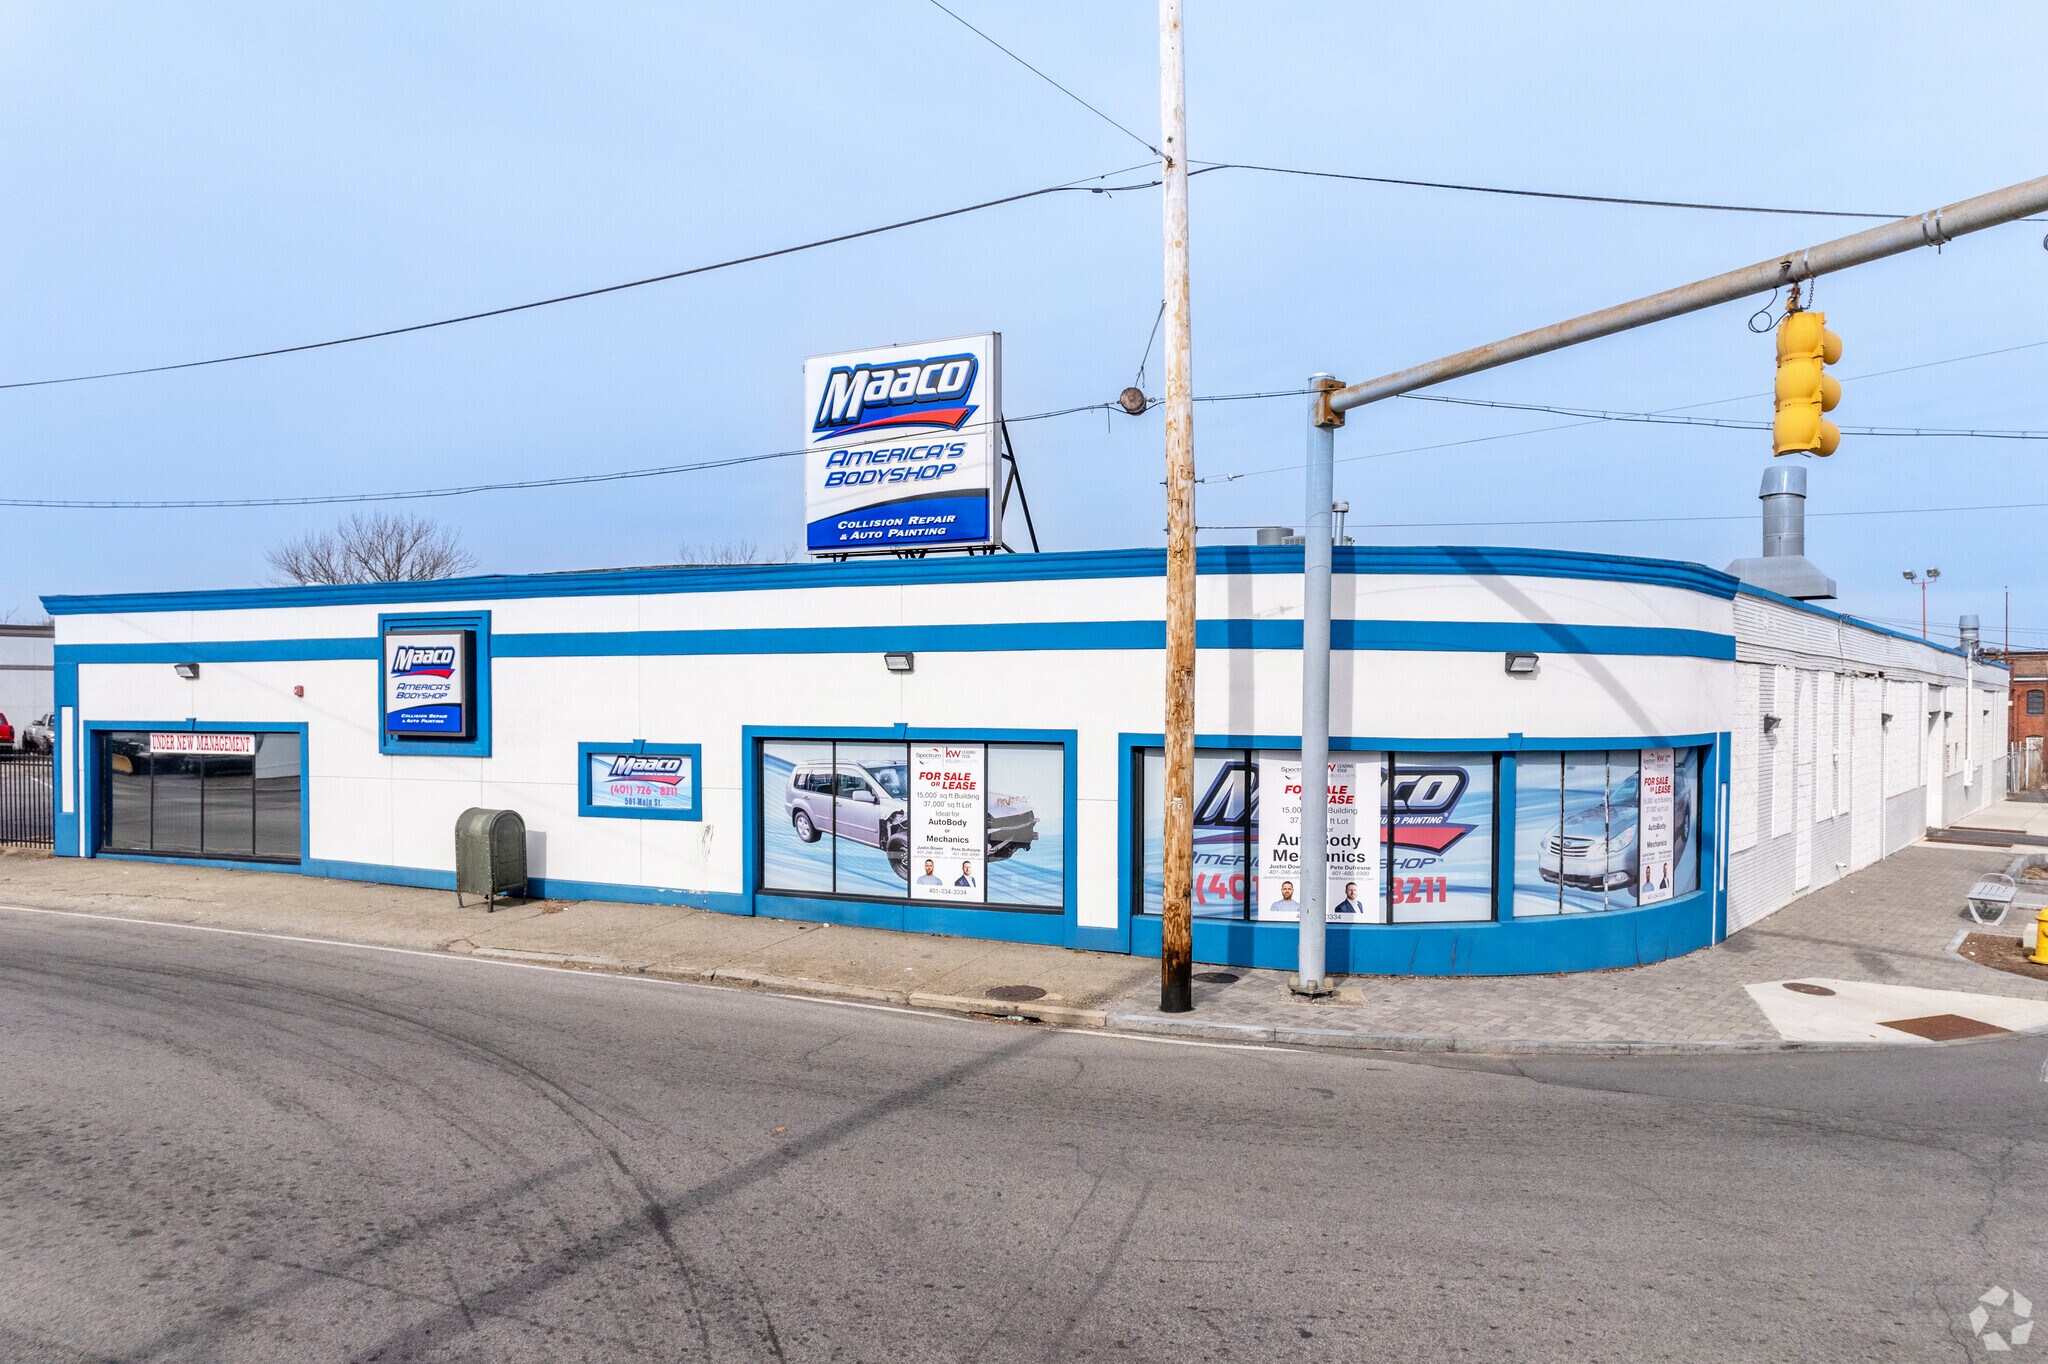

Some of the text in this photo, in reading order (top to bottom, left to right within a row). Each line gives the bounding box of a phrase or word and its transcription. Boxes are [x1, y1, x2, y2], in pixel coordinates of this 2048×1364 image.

[819, 359, 972, 424] Maaco
[826, 442, 967, 468] AMERICA'S
[825, 463, 958, 488] BODYSHOP
[838, 515, 956, 530] COLLISION REPAIR
[850, 530, 883, 540] AUTO
[887, 527, 946, 538] PAINTING
[394, 648, 453, 671] Maaco
[396, 692, 448, 700] BODYSHOP
[152, 735, 250, 752] UNDER NEW MANAGEMENT
[946, 747, 961, 758] kw
[611, 757, 681, 776] Maaco
[919, 772, 971, 781] FOR SALE
[1644, 776, 1668, 786] FOR SALE
[610, 785, 633, 796] (401)
[636, 785, 651, 795] 726
[660, 786, 677, 796] 8211
[942, 782, 976, 790] LEASE
[1284, 785, 1302, 794] FO
[1655, 785, 1671, 794] LEASE
[954, 792, 980, 800] Building
[637, 797, 652, 807] Main
[1328, 807, 1358, 815] Building
[928, 818, 967, 828] AutoBody
[1401, 816, 1444, 824] PAINTING
[926, 835, 969, 844] Mechanics
